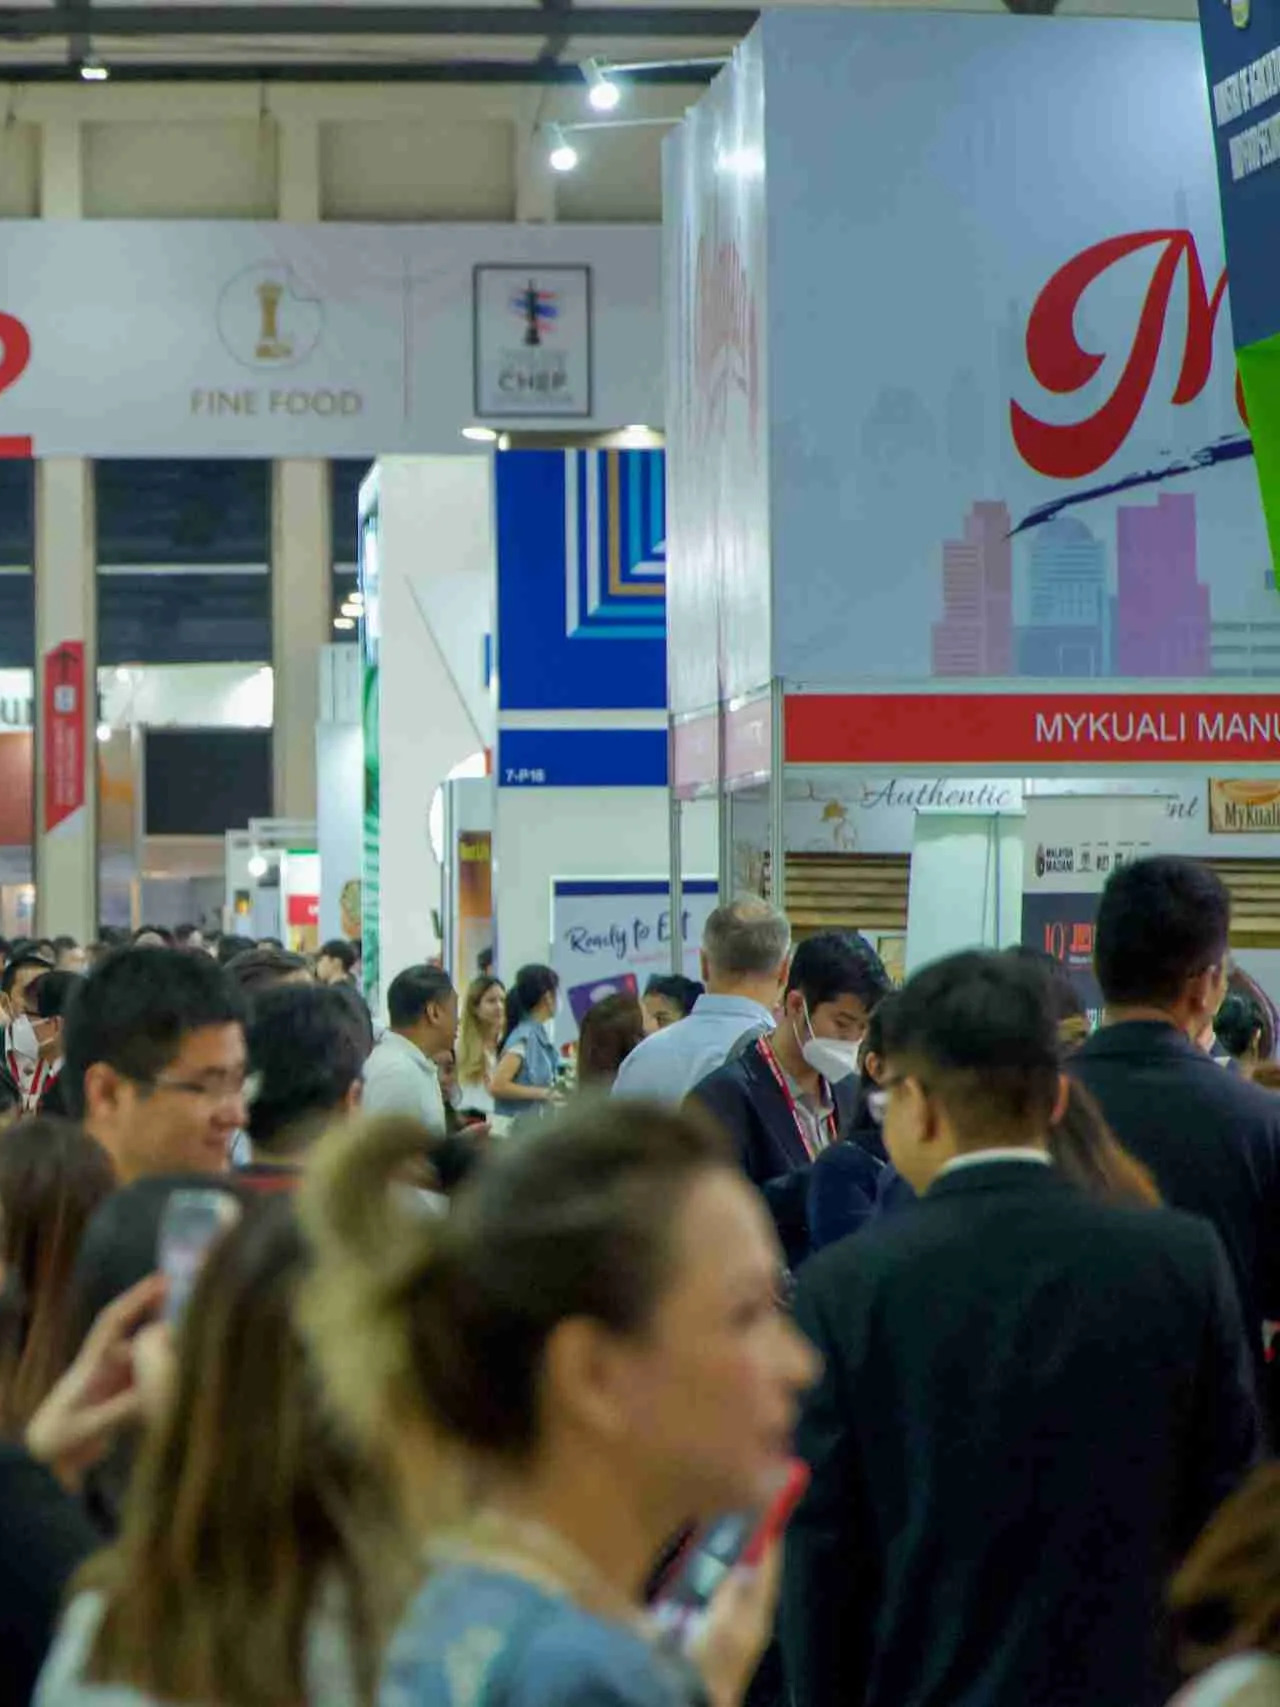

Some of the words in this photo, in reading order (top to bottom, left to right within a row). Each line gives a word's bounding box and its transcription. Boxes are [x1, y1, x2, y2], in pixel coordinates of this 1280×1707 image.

[190, 389, 258, 416] FINE
[268, 389, 364, 416] FOOD
[1035, 712, 1186, 743] MYKUALI
[860, 778, 1014, 810] Authentic
[657, 910, 692, 943] Et
